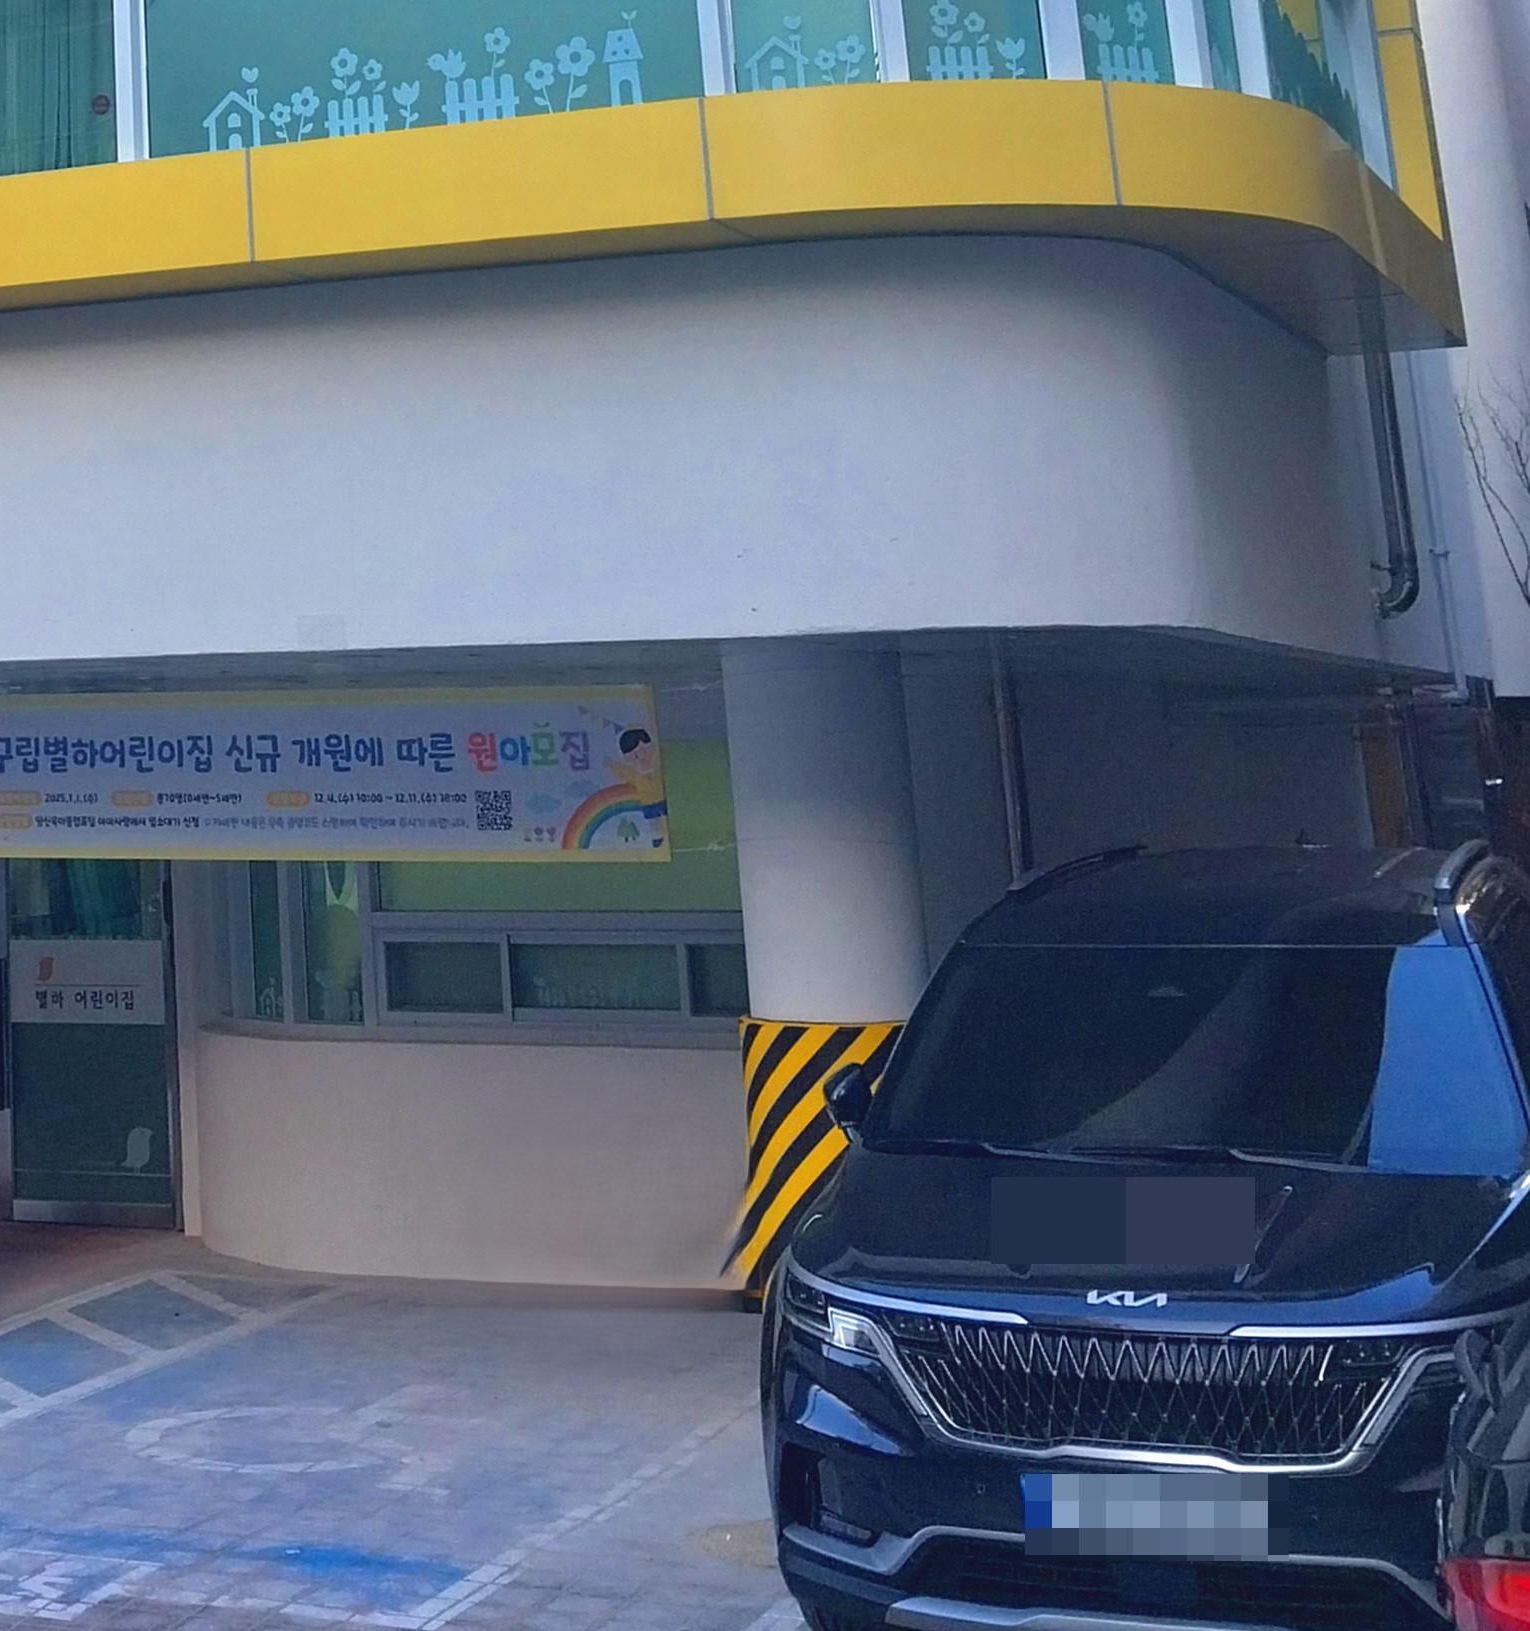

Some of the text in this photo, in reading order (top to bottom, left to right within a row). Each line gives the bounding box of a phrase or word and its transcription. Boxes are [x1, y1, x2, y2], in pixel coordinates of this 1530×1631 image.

[225, 734, 282, 773] 신규
[291, 733, 384, 773] 개원에
[395, 732, 456, 773] 따른
[467, 730, 590, 772] 원아모집
[35, 989, 134, 1011] 별하 어린이집
